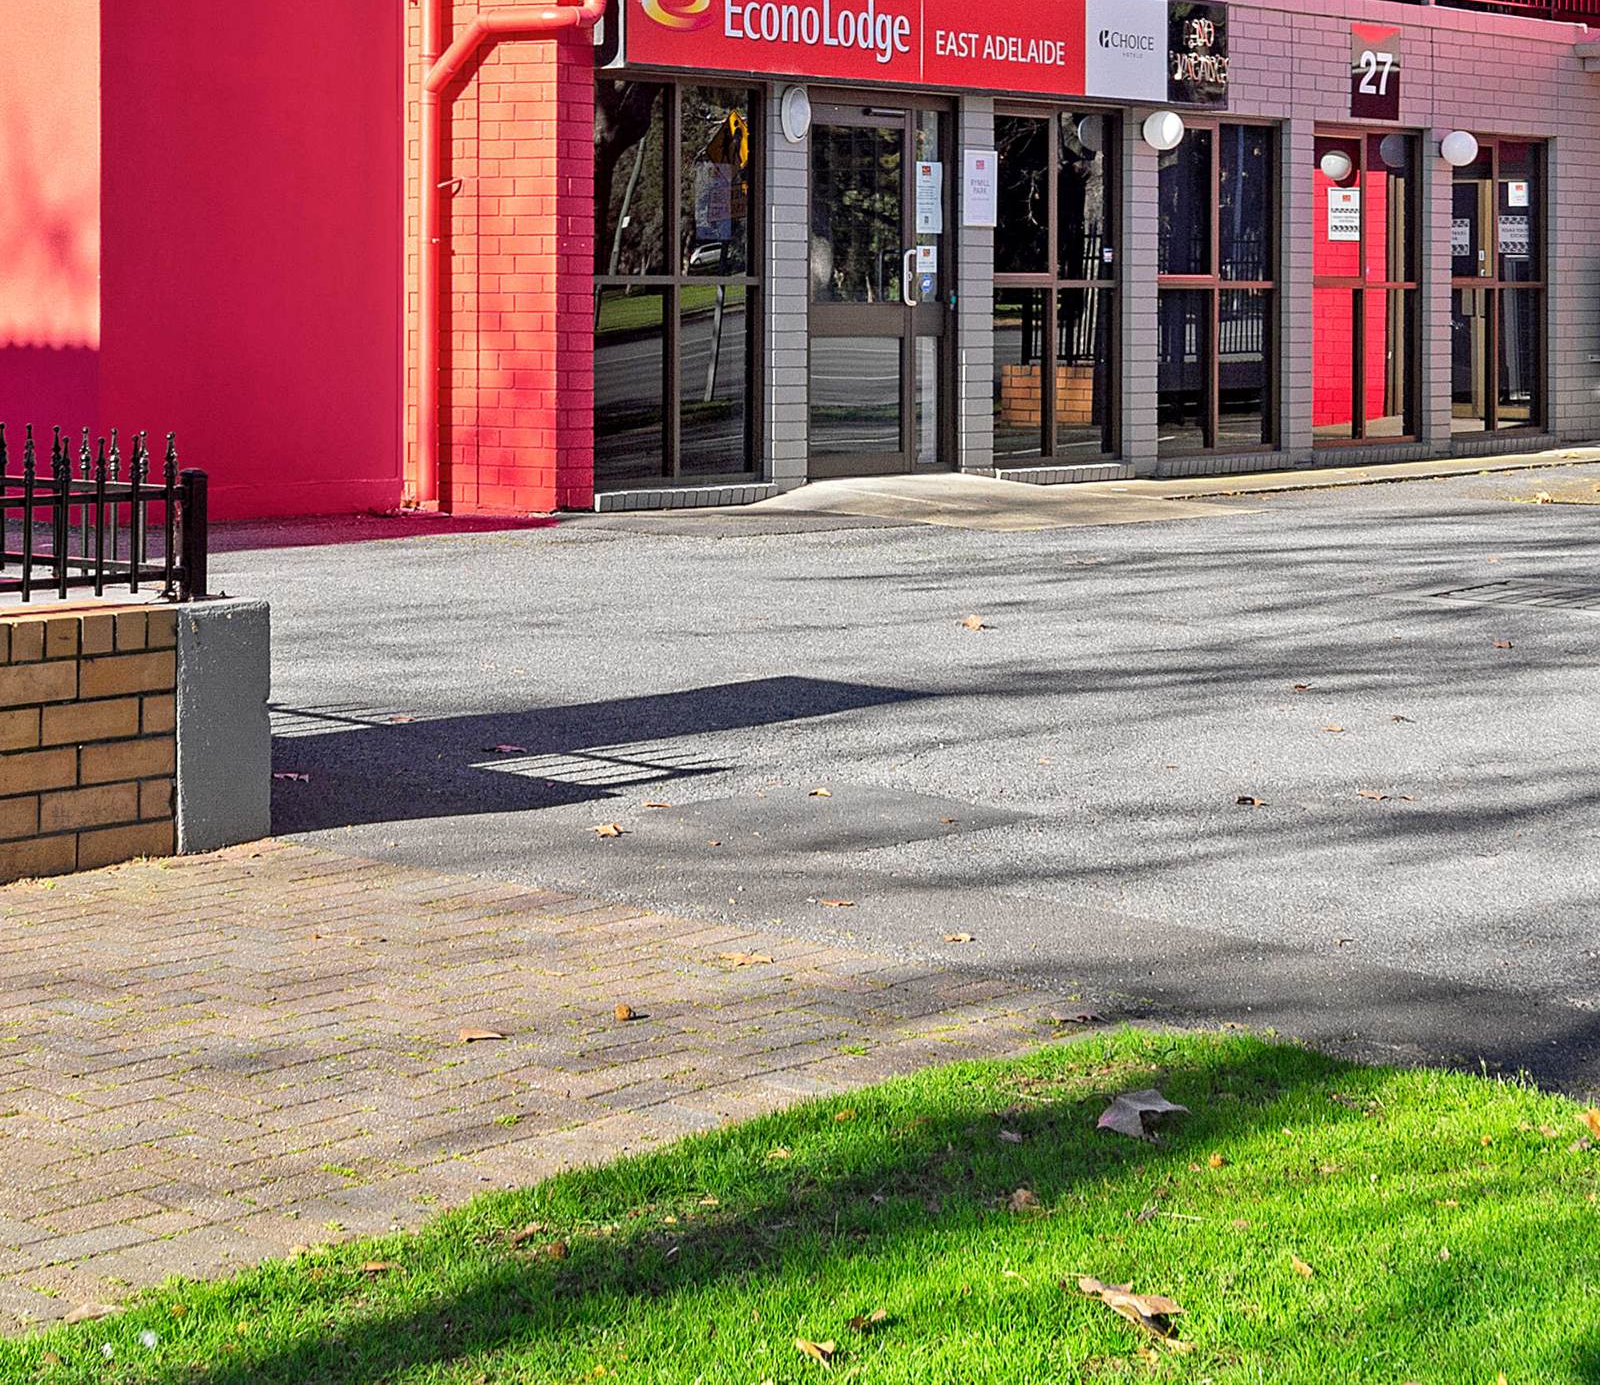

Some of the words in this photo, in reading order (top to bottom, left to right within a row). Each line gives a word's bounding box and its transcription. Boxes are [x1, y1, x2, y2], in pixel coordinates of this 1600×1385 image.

[935, 30, 979, 58] EAST
[983, 35, 1065, 65] ADELAIDE
[1111, 31, 1154, 51] CHOICE
[1358, 50, 1393, 96] 27
